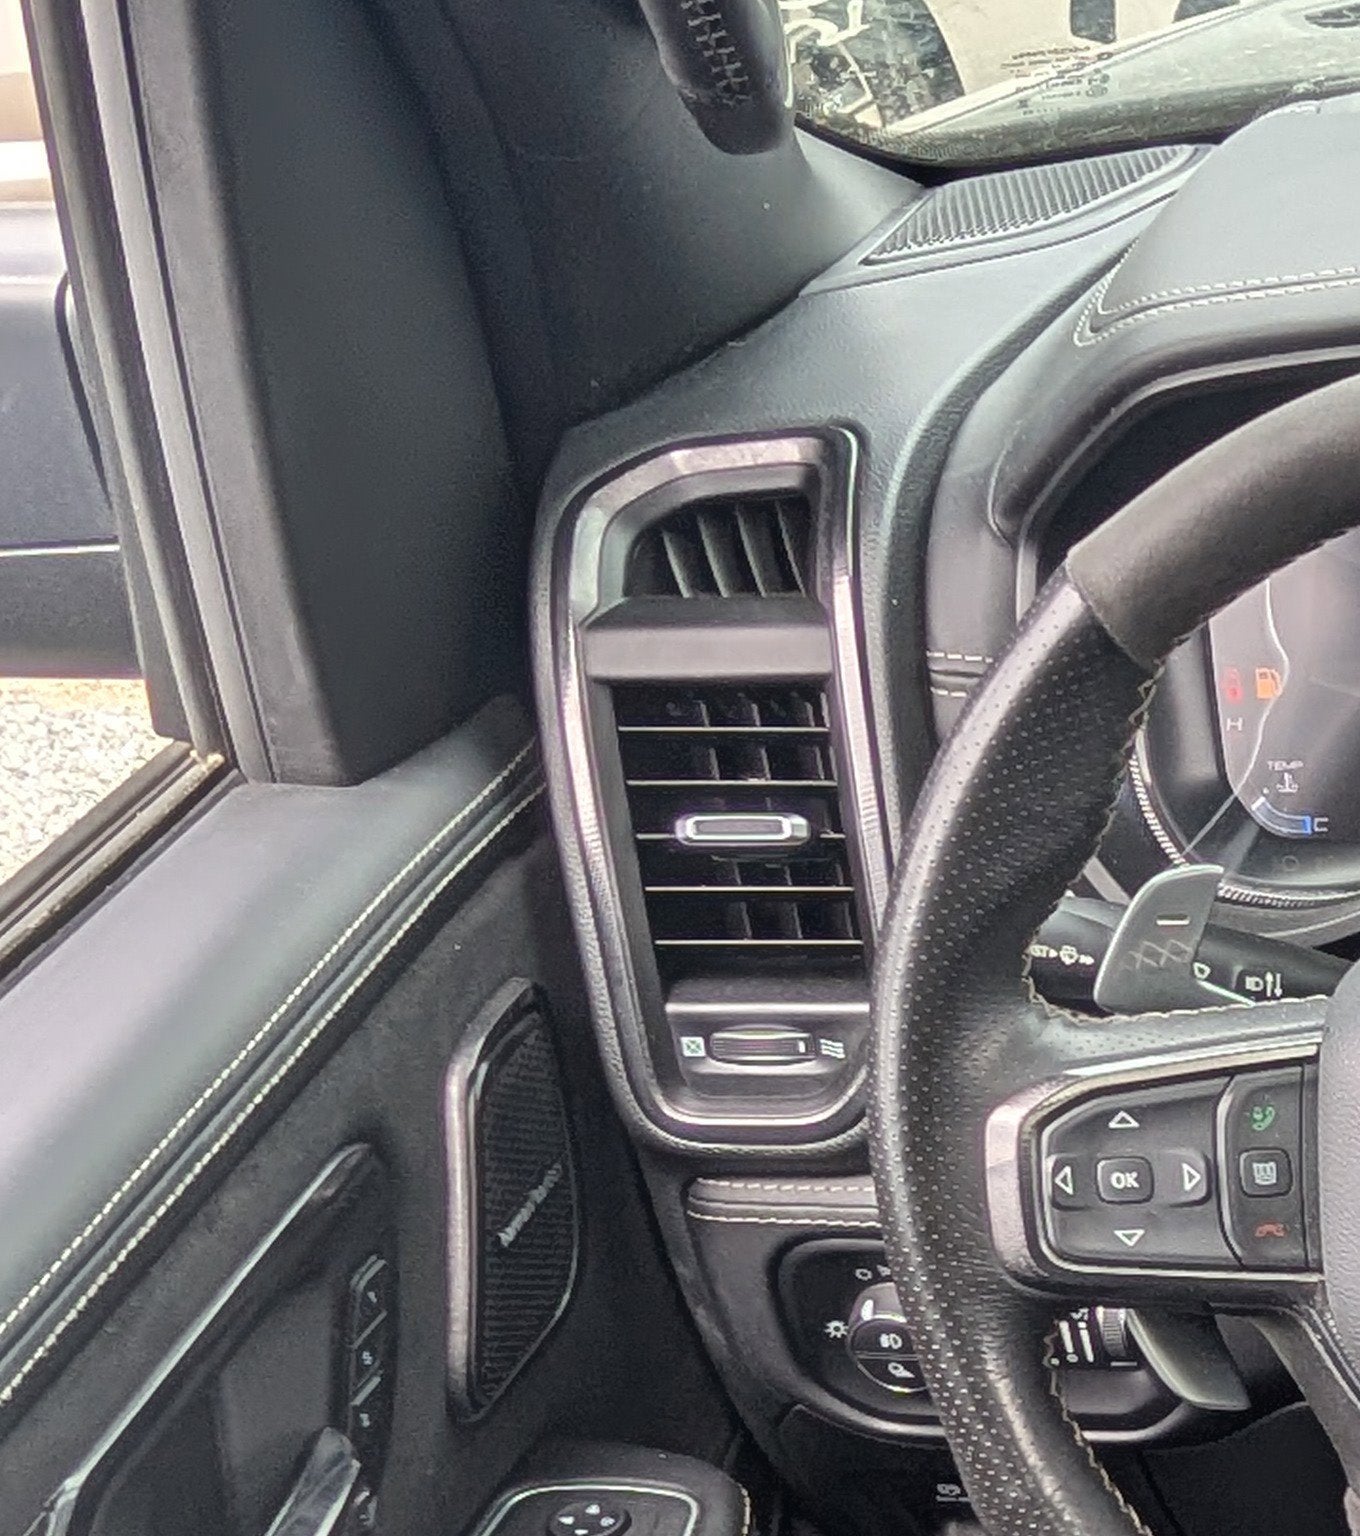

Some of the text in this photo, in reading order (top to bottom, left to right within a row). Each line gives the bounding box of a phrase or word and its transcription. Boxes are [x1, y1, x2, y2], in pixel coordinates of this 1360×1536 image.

[1226, 717, 1243, 732] H
[1267, 760, 1304, 771] TEMP
[1312, 817, 1329, 833] C
[1110, 1171, 1140, 1189] OK
